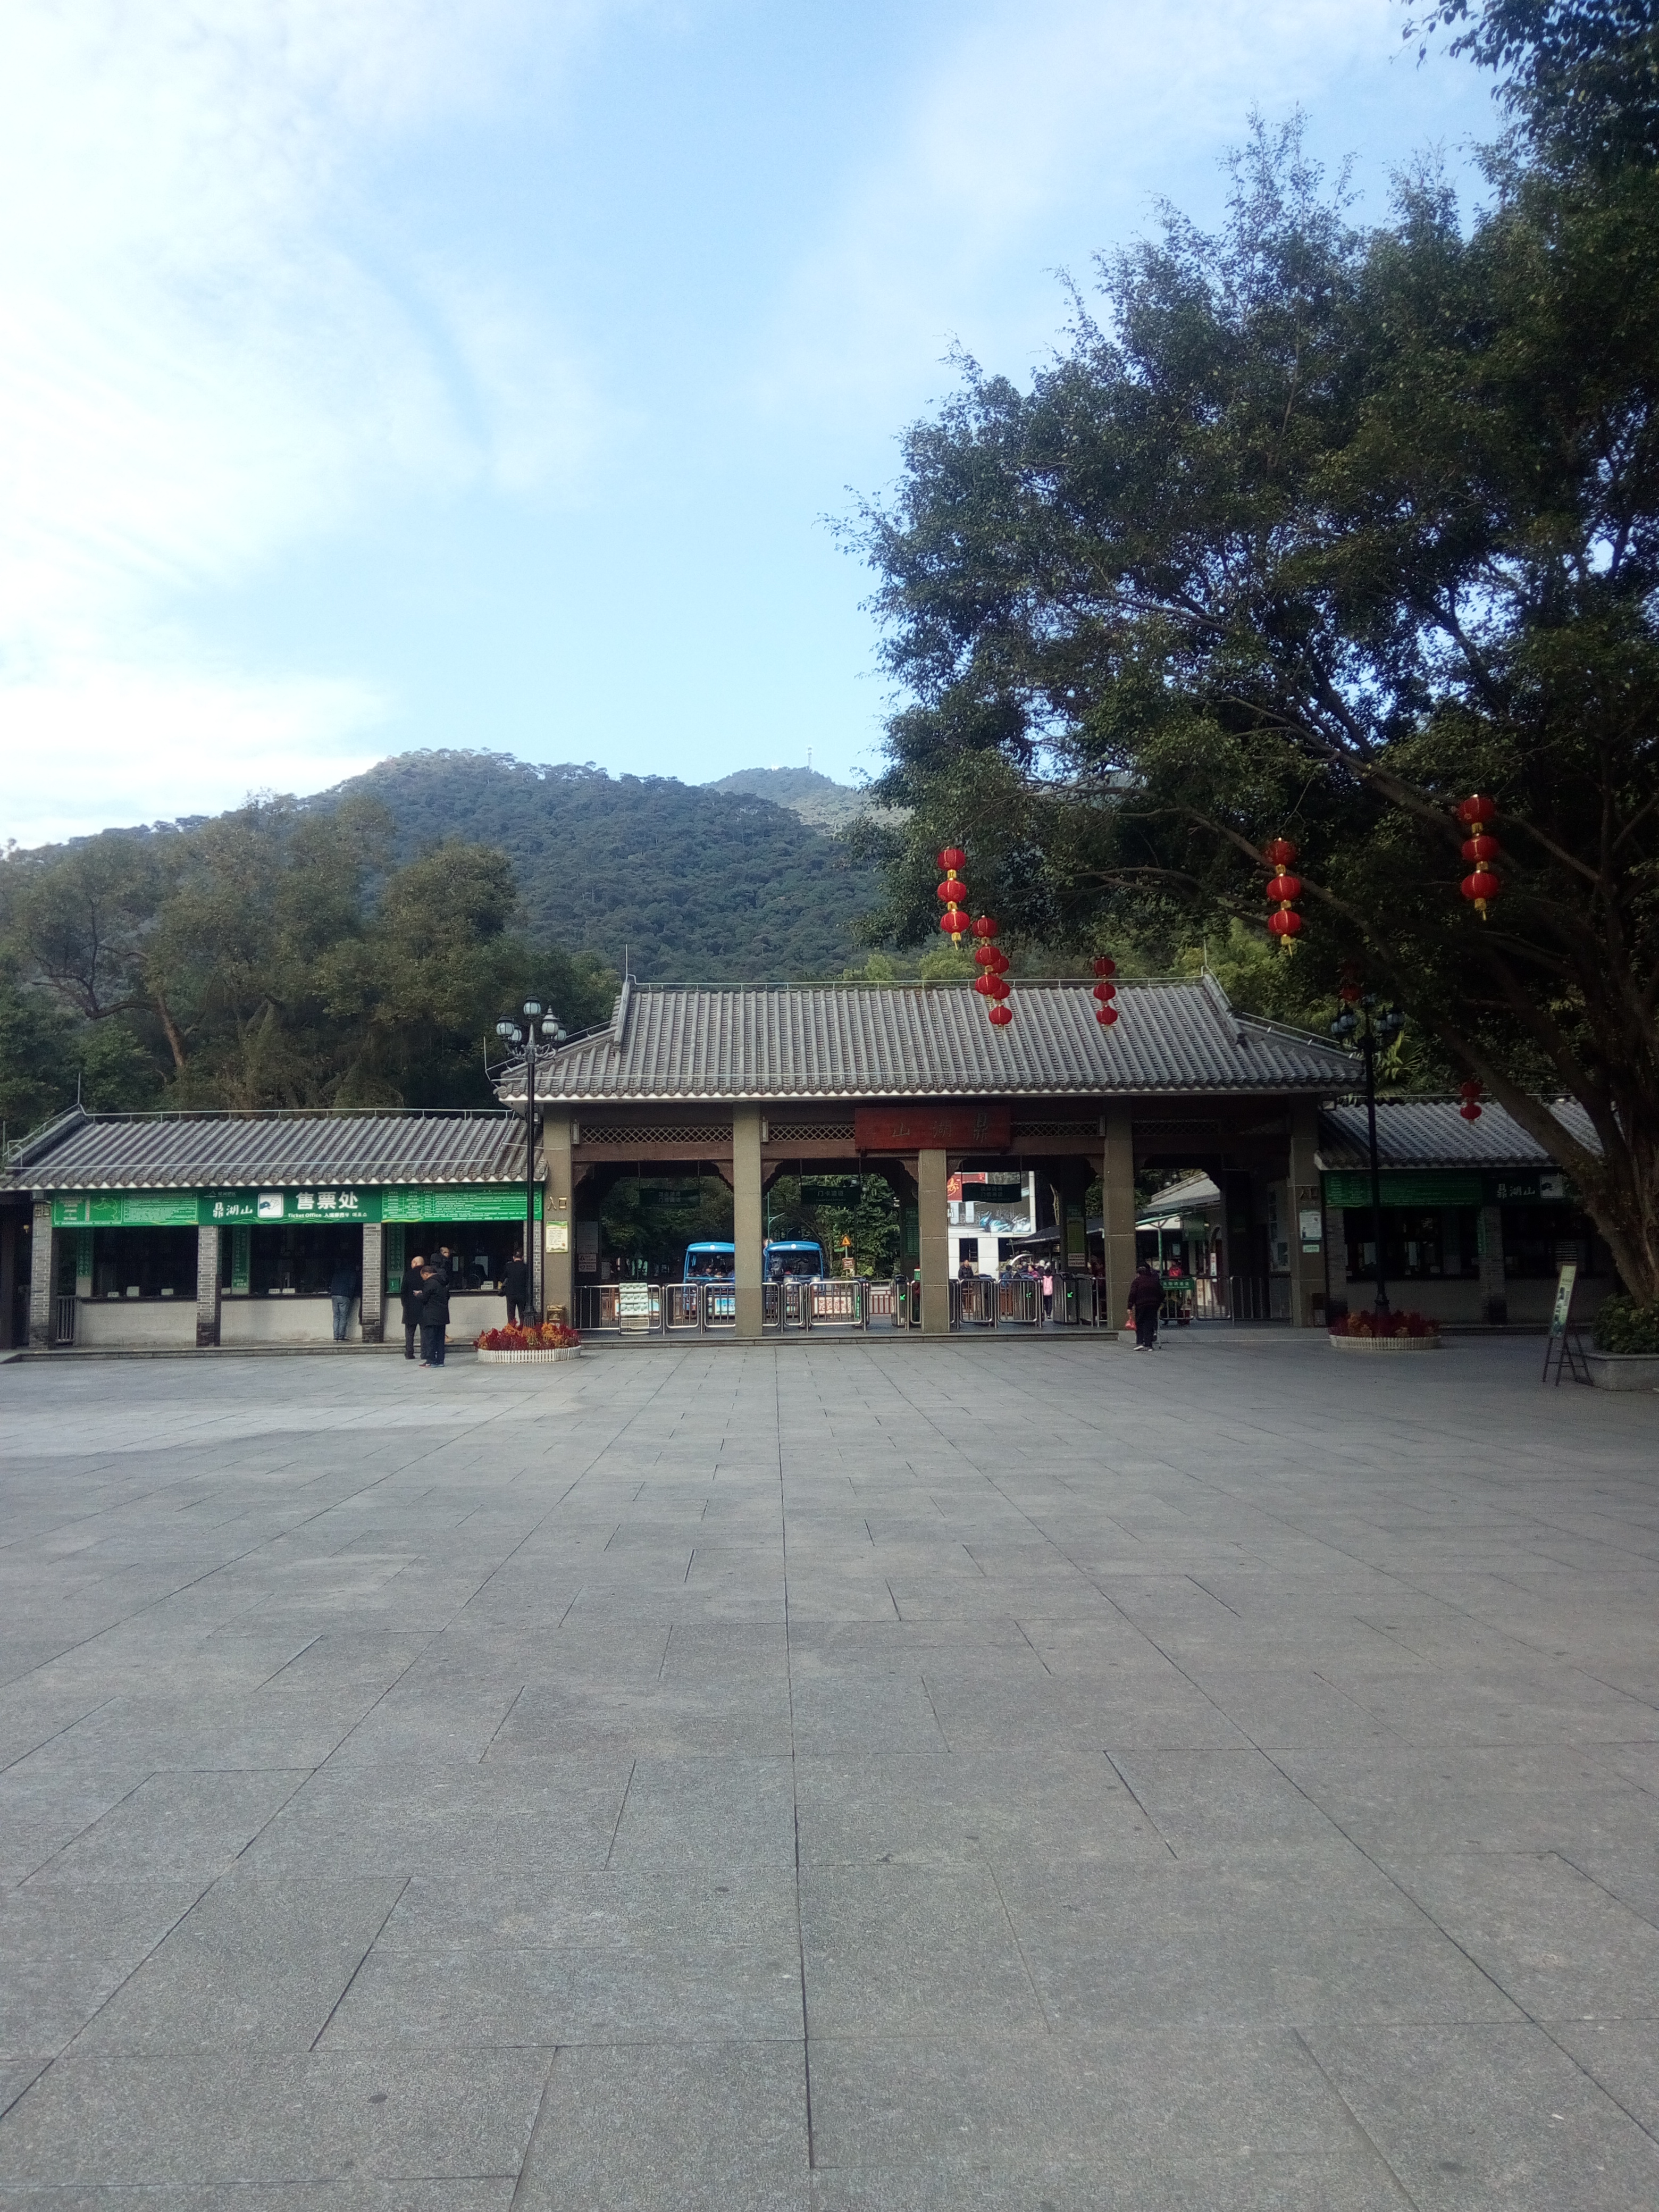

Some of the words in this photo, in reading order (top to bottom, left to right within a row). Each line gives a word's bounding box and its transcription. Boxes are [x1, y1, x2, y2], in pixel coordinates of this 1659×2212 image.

[1497, 1184, 1536, 1199] 鼎湖山
[296, 1191, 358, 1210] 售票处
[547, 1196, 567, 1211] 入口
[213, 1202, 253, 1218] 鼎湖山
